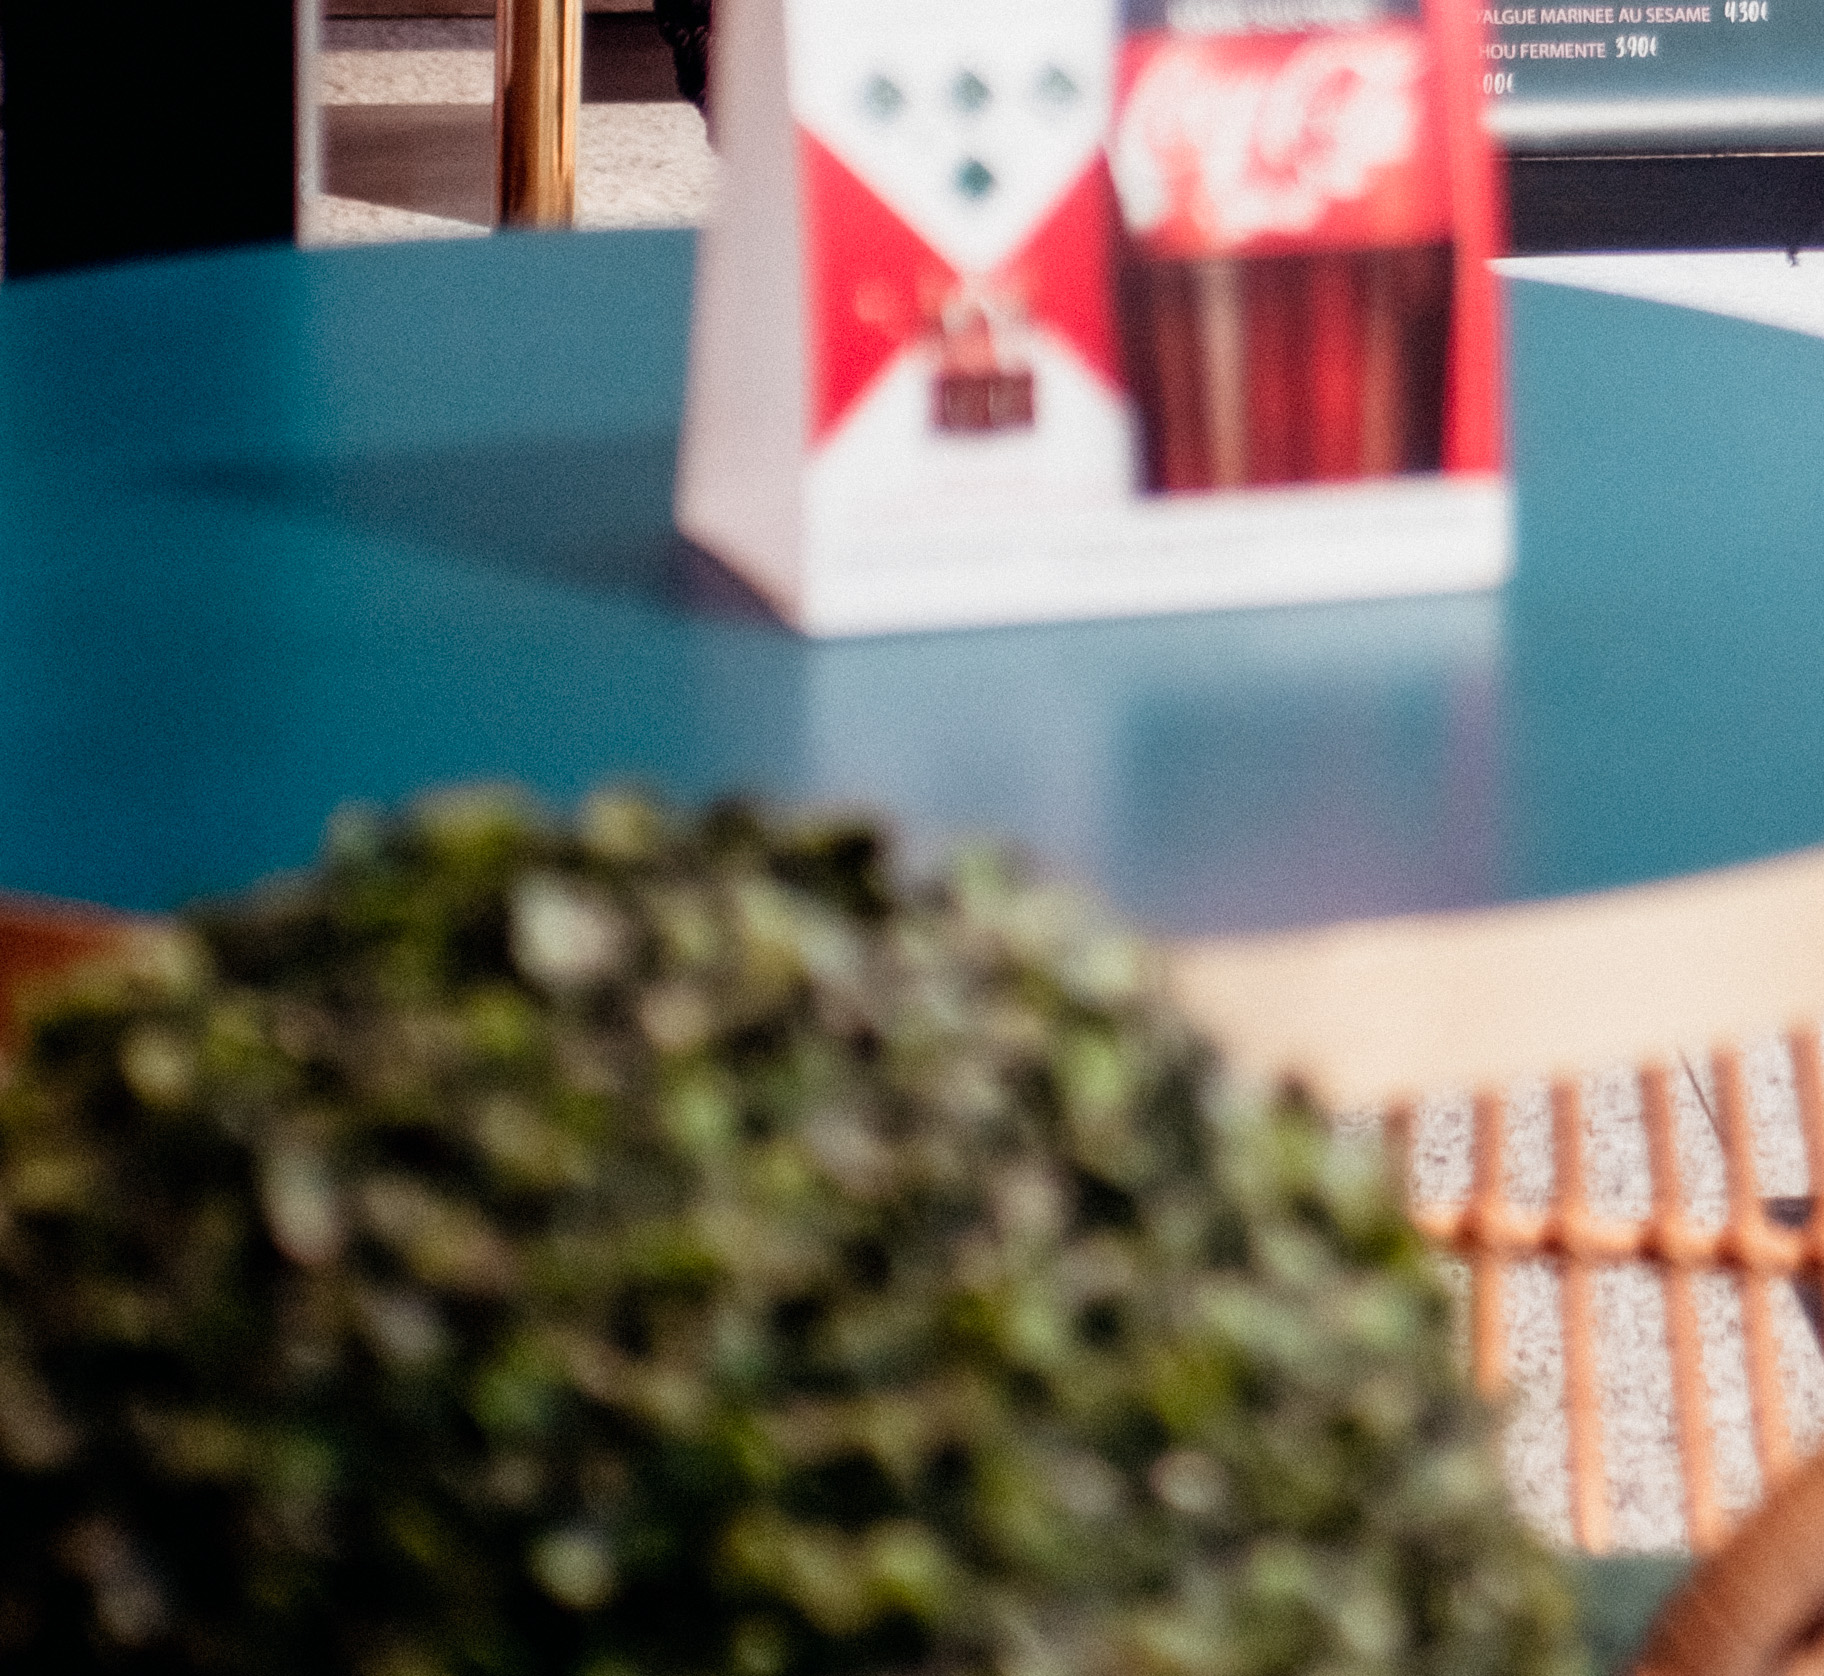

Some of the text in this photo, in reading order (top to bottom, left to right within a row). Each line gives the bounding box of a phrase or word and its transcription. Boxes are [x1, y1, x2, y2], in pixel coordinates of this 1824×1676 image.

[1541, 6, 1710, 23] MARINEE AU SESAME
